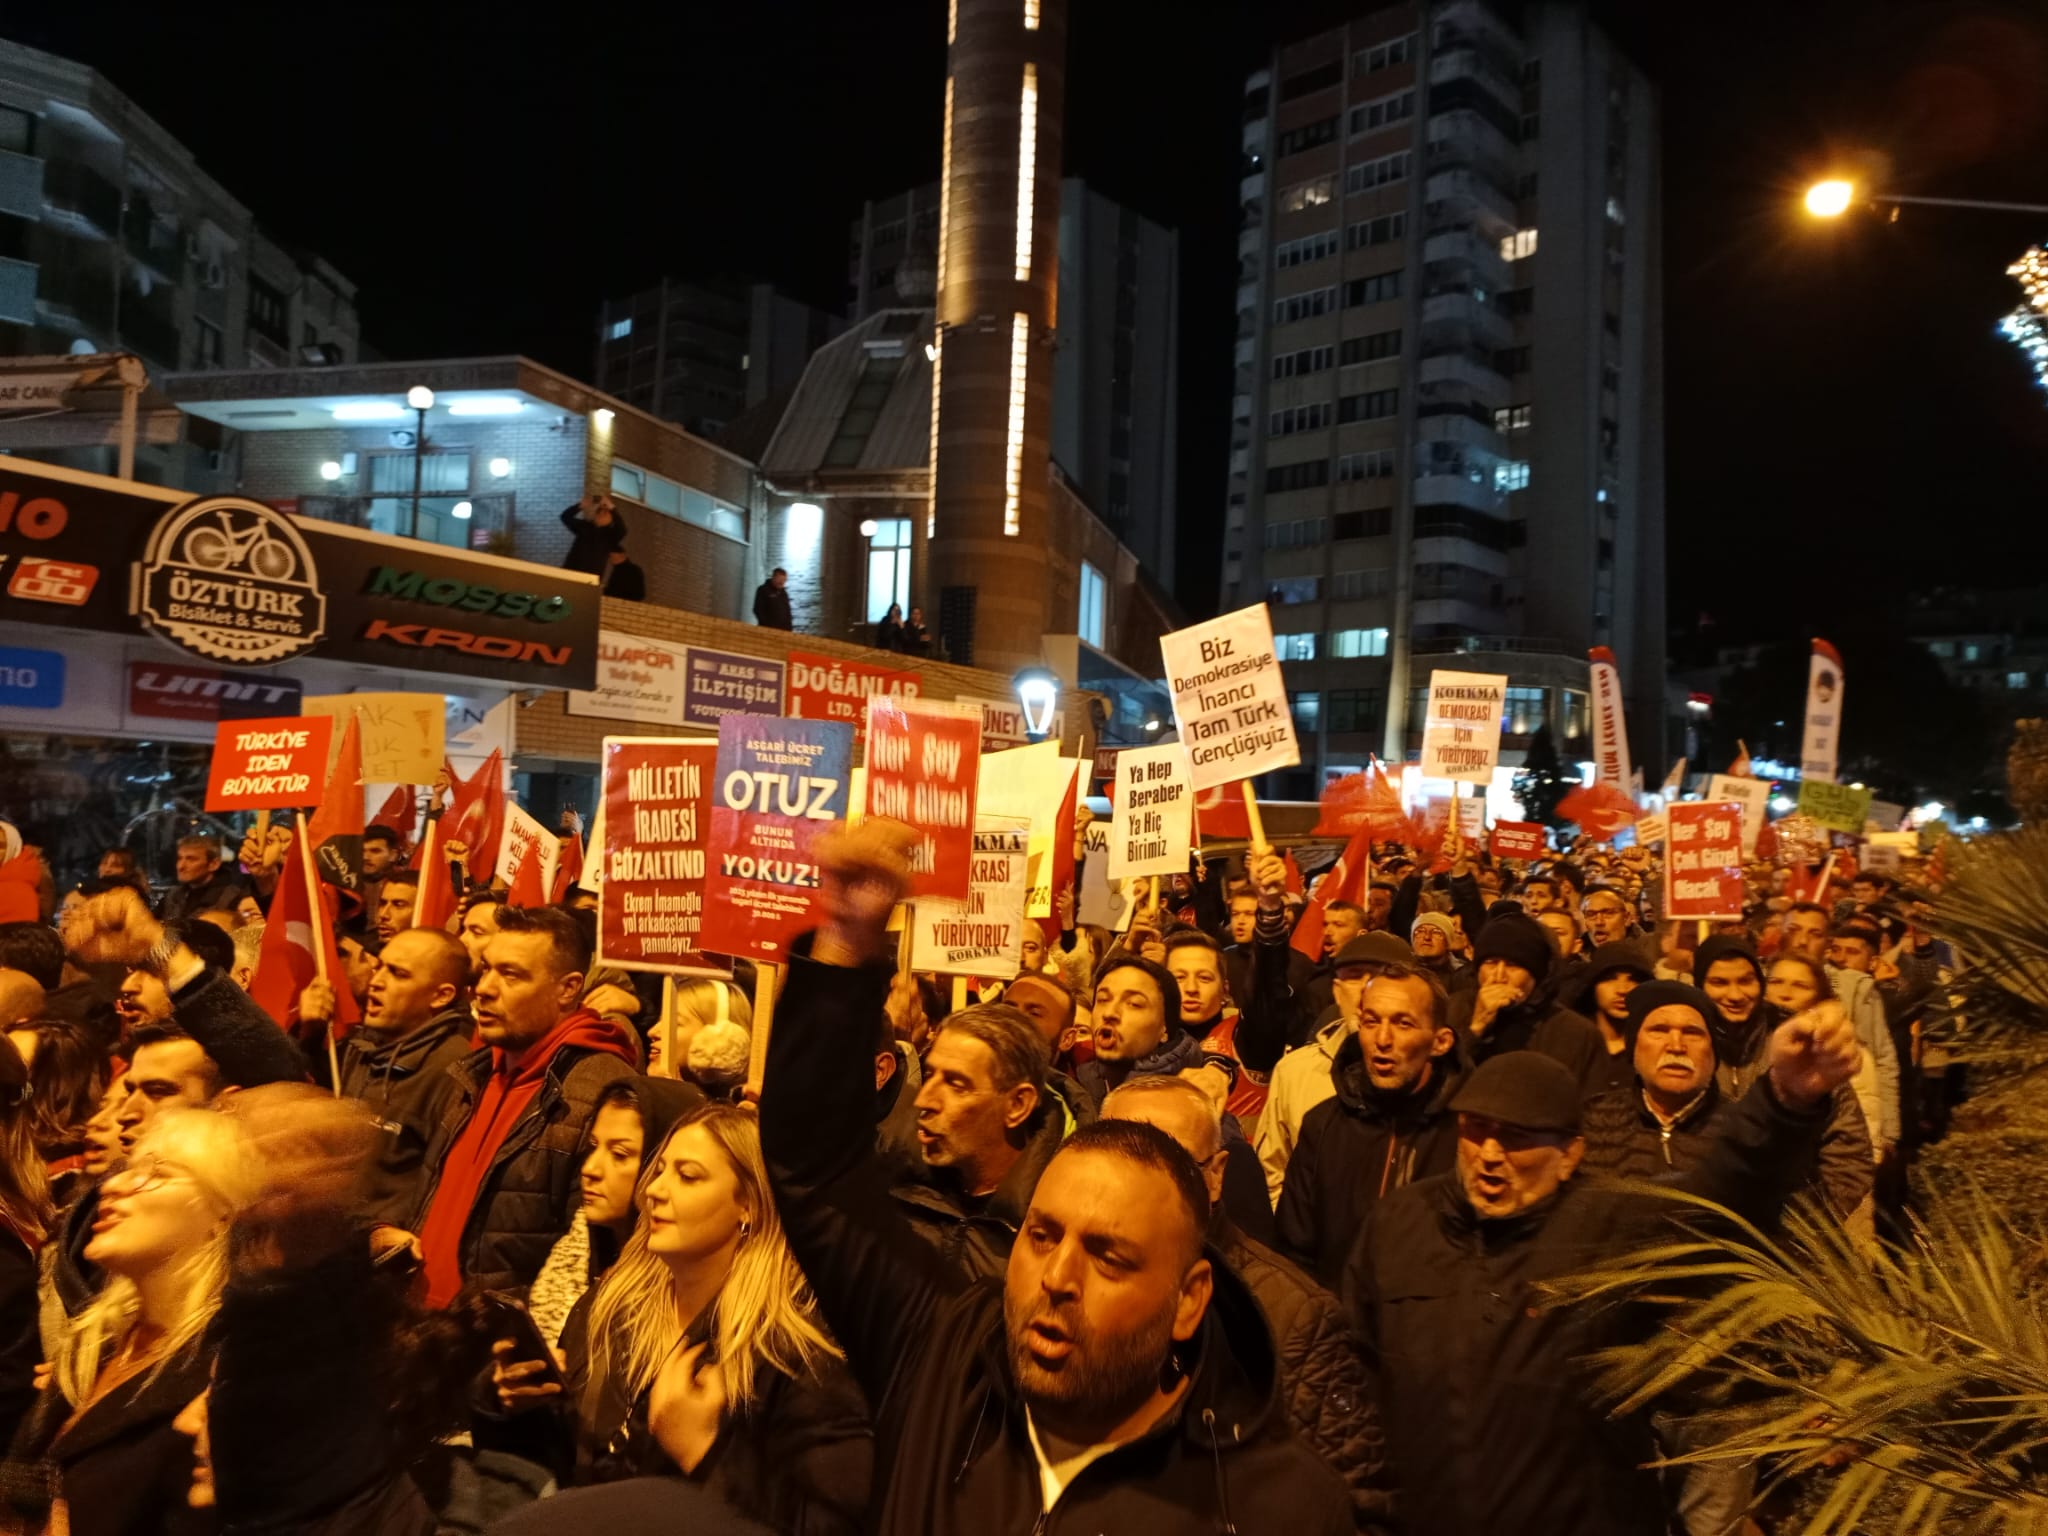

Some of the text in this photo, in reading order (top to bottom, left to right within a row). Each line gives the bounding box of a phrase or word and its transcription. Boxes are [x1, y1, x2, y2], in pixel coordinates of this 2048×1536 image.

[169, 569, 304, 618] ÖZTÜRK
[368, 566, 573, 623] MOSSO
[168, 603, 302, 634] Bisiklet & Servis
[364, 619, 573, 665] KRON
[1200, 637, 1235, 664] Biz
[791, 662, 918, 700] DOĞANLAR
[1174, 652, 1272, 694] Demokrasiye
[693, 674, 777, 704] İLETİŞİM
[1198, 683, 1256, 712] İnancı
[1434, 687, 1499, 699] KORKMA
[827, 701, 856, 718] LTD.
[1188, 701, 1279, 741] Tam Türk
[1439, 702, 1492, 722] DEMOKRASİ
[236, 729, 310, 752] TÜRKİYE
[746, 738, 825, 755] ASGARİ ÜCRET
[1192, 725, 1288, 766] Gençliğiyiz
[756, 752, 812, 767] TALEBİMİZ
[1436, 744, 1489, 766] YÜRÜYORUZ
[221, 773, 310, 796] BÜYÜKTÜR
[628, 759, 701, 801] MİLLETİN
[1129, 761, 1172, 784] Ya Hep
[723, 769, 838, 820] OTUZ
[1129, 783, 1183, 809] Beraber
[634, 801, 697, 844] İRADESİ
[754, 824, 794, 838] BUNUN
[1129, 809, 1162, 836] Ya Hiç
[749, 836, 796, 850] ALTINDA
[973, 834, 1021, 851] KMA
[1128, 836, 1167, 862] Birimiz
[611, 846, 705, 882] GÖZALTIND
[723, 853, 819, 888] YOKUZ!
[971, 855, 1010, 883] KRASİ
[623, 888, 702, 915] Ekrem İmamoğlu
[622, 912, 702, 936] yol arkadaşlarım
[932, 919, 1010, 947] YÜRÜYORUZ
[947, 946, 1001, 963] KORKMA
